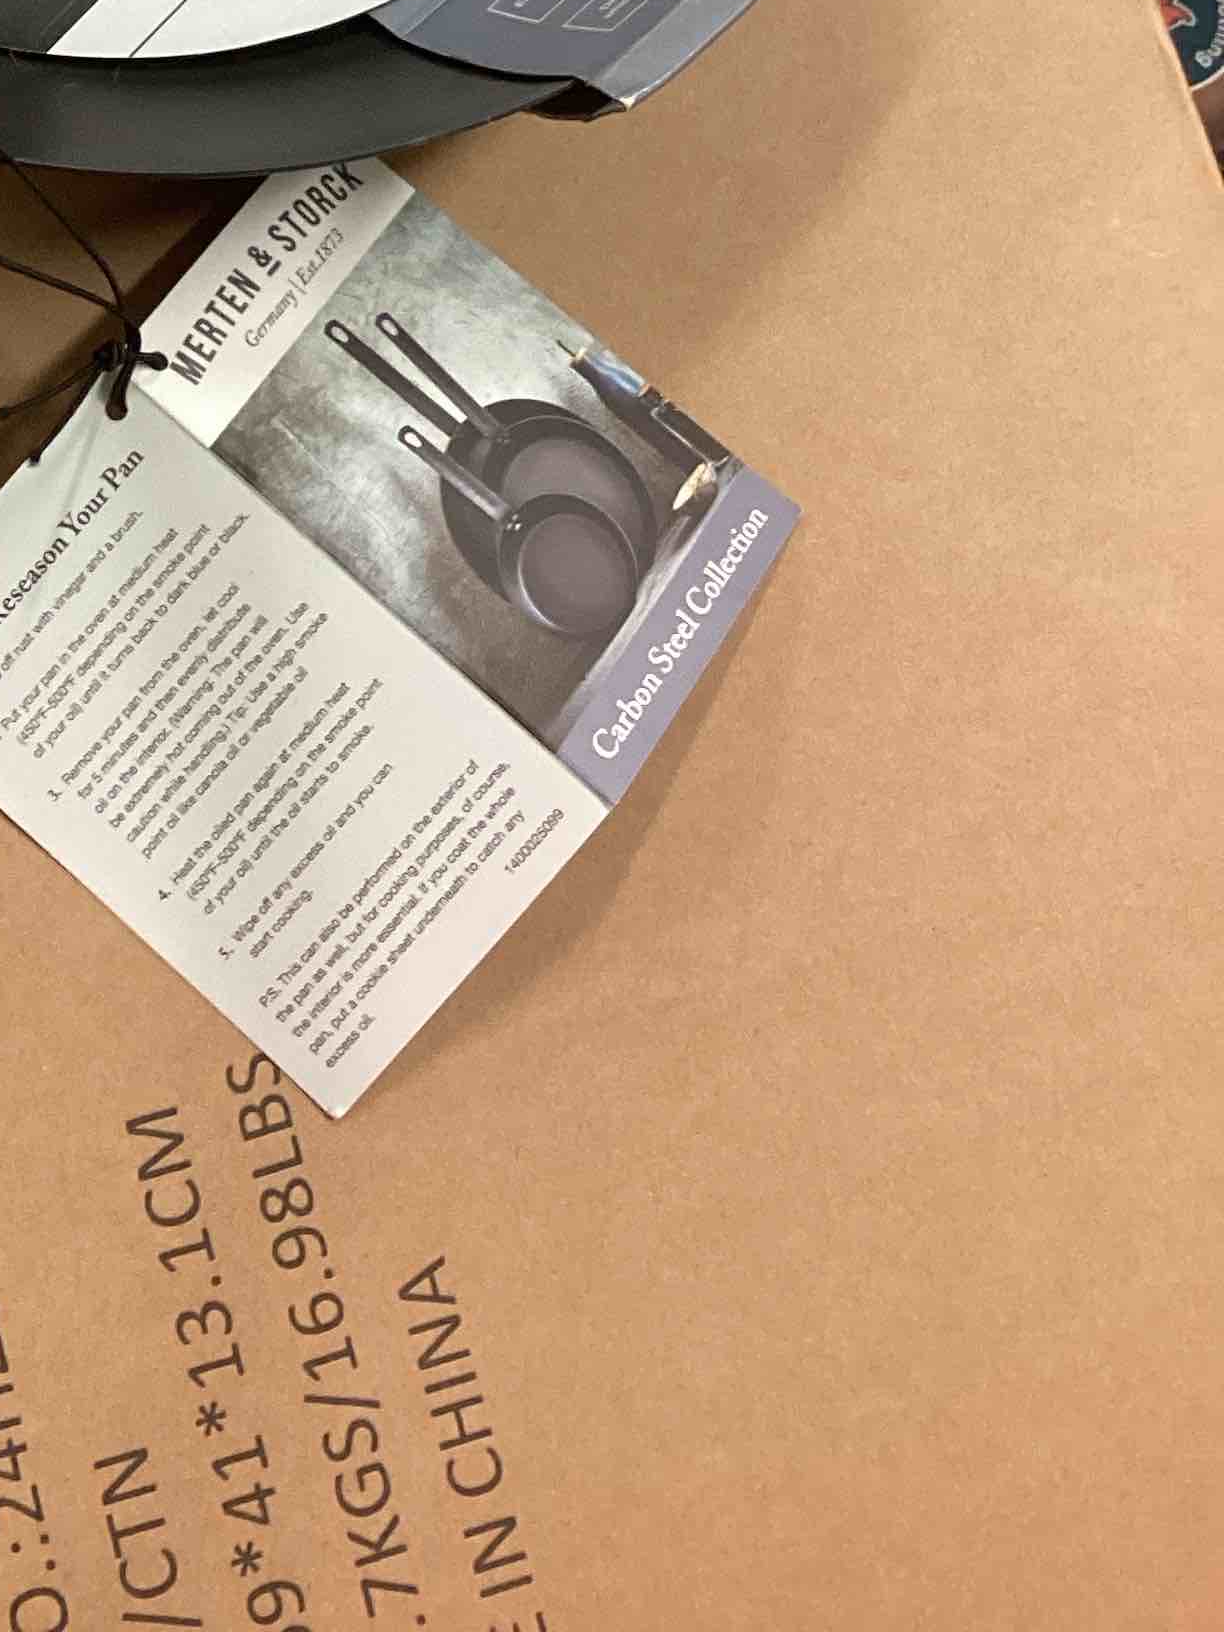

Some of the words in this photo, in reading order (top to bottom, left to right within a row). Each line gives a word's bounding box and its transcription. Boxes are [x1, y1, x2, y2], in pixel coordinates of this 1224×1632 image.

[169, 267, 261, 386] MERTEN
[247, 245, 282, 277] &
[267, 162, 365, 252] STORCK
[244, 289, 299, 348] Germany
[295, 226, 345, 286] Est.1873
[56, 487, 110, 537] Your
[99, 450, 145, 492] Pan
[592, 673, 664, 759] Carbon
[647, 608, 701, 675] Steel
[685, 509, 769, 615] Collection
[397, 1255, 505, 1500] CHINA
[93, 1446, 203, 1630] /CTN
[463, 1513, 534, 1600] IN
